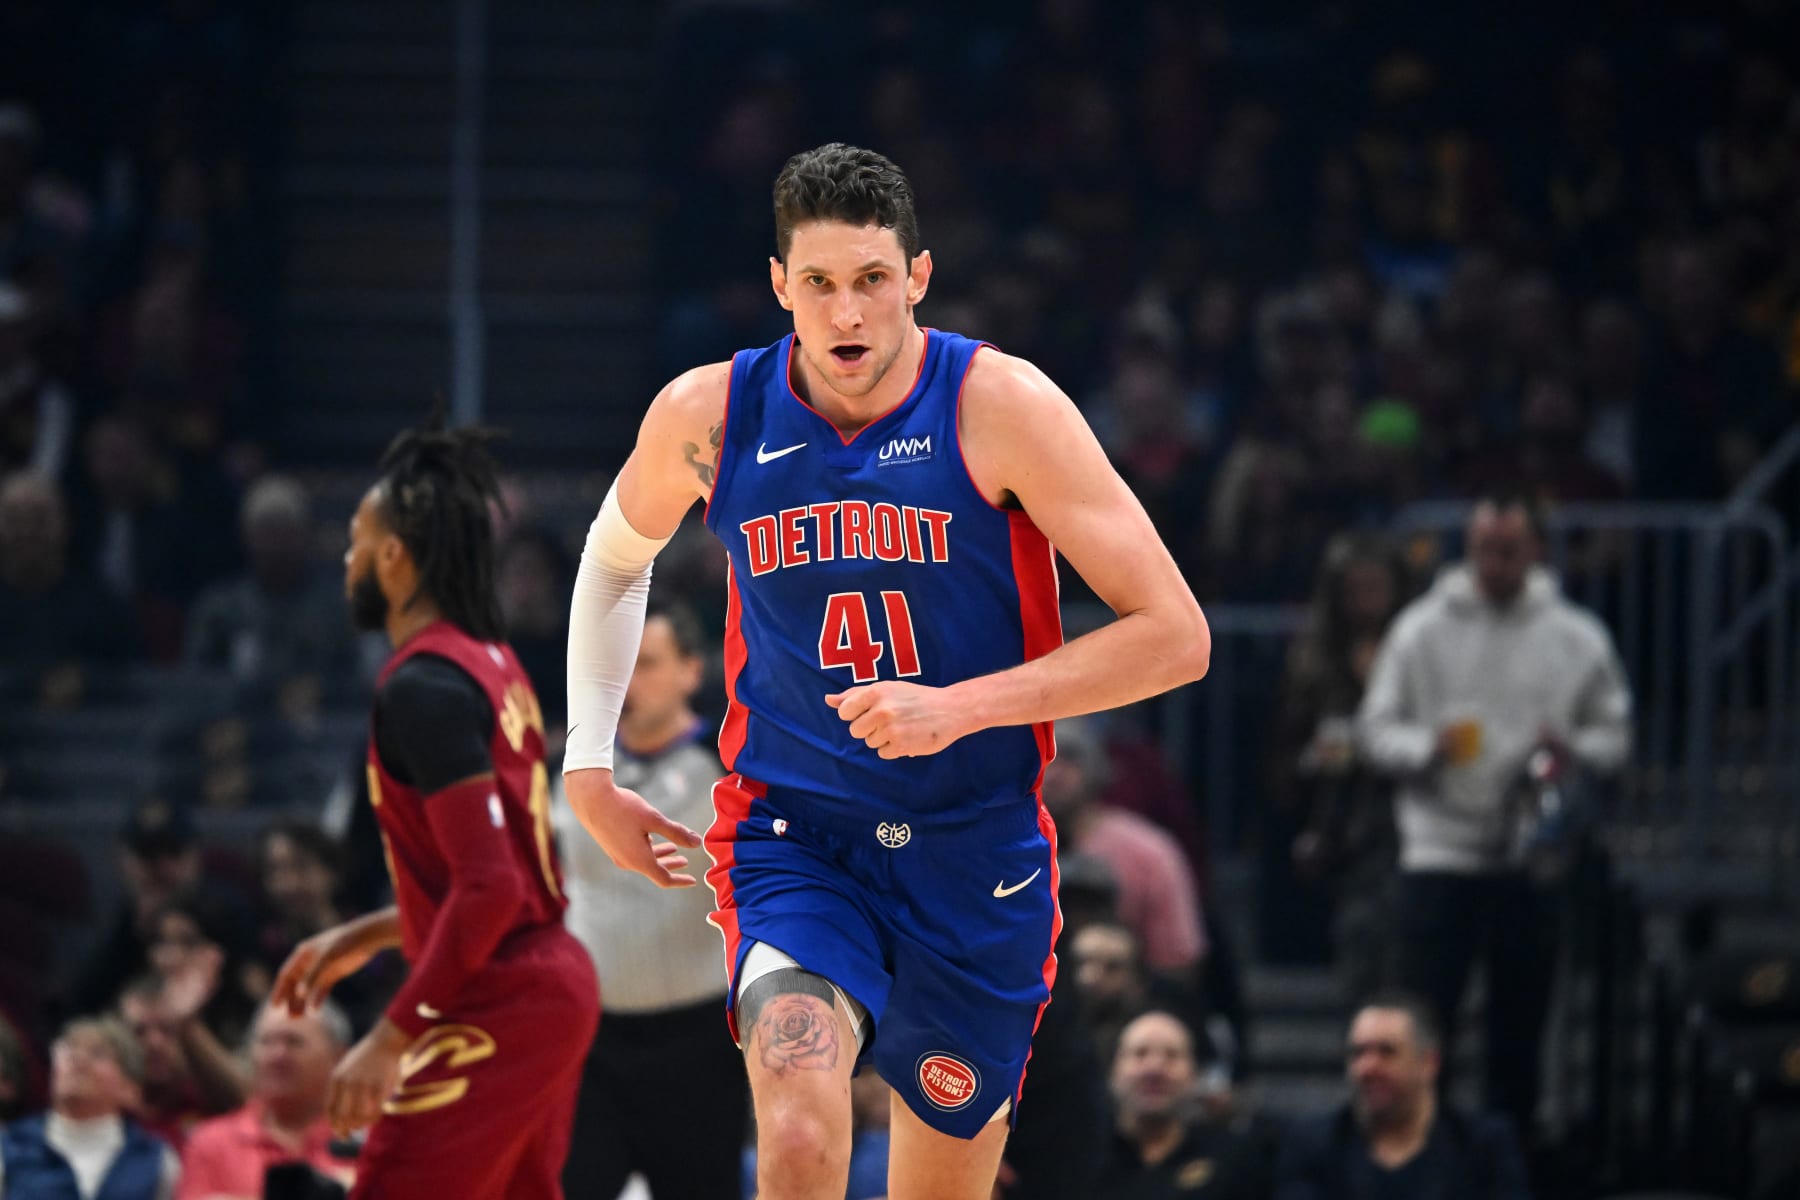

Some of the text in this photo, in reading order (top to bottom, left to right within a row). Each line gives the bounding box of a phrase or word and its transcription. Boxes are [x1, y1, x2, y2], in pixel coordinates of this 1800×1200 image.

[879, 435, 931, 459] UWM
[740, 500, 952, 577] DETROIT
[818, 591, 921, 683] 41
[926, 1071, 965, 1098] PISTONS
[930, 1064, 968, 1089] DETROIT
